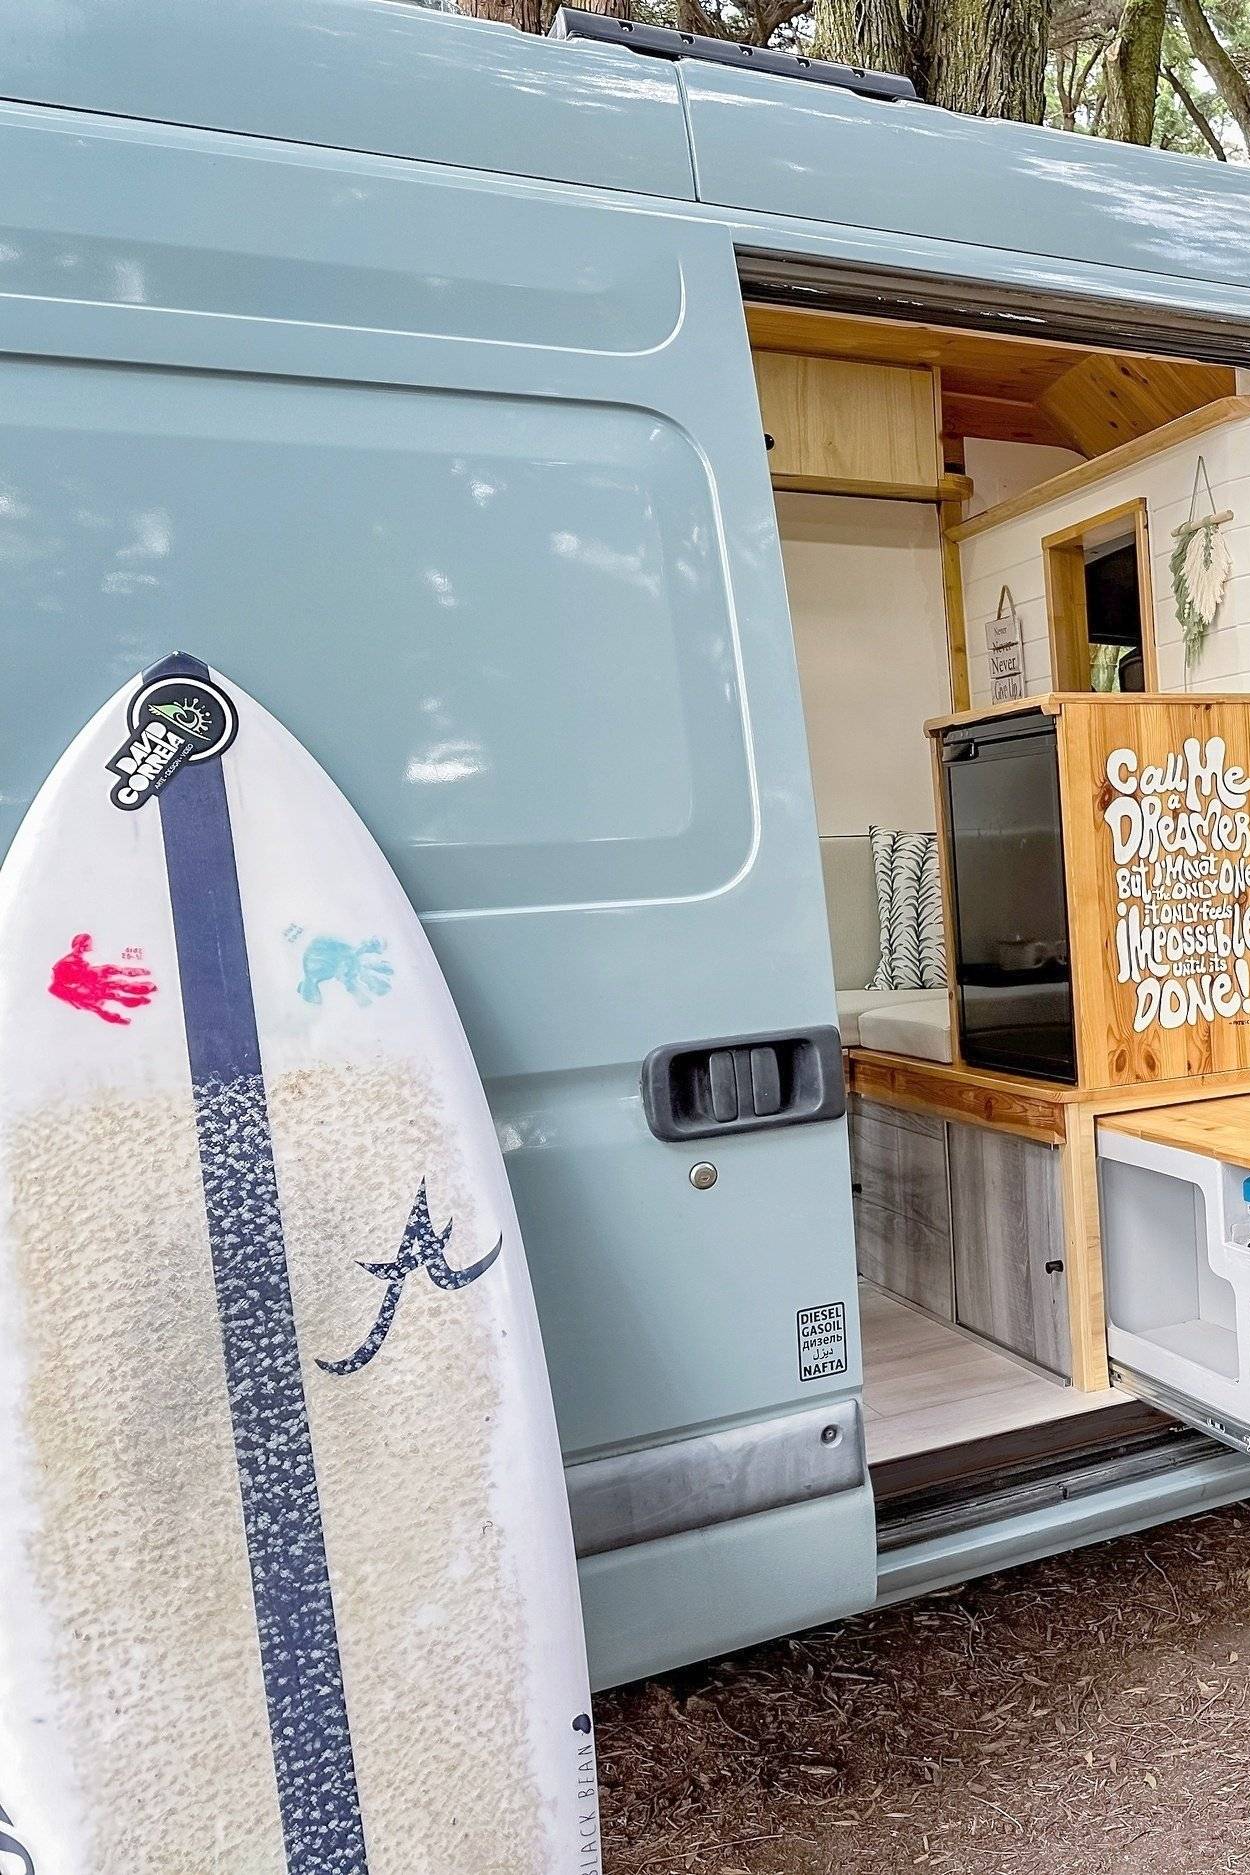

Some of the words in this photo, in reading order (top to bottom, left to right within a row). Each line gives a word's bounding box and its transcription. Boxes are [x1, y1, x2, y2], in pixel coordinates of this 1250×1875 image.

[991, 657, 1015, 674] Never
[115, 721, 168, 776] DAVID
[117, 731, 186, 805] CORREIA
[1106, 748, 1187, 795] Call
[1167, 794, 1182, 809] a
[1116, 859, 1152, 904] But
[1152, 884, 1171, 901] the
[1171, 880, 1219, 900] ONLY
[1160, 903, 1200, 924] ONLY
[1199, 898, 1233, 921] feels
[800, 1307, 841, 1325] DIESEL
[801, 1320, 842, 1337] GASOIL
[802, 1334, 843, 1351] дизель
[813, 1347, 834, 1361] ديزل
[803, 1359, 844, 1377] NAFTA
[577, 1744, 595, 1799] BEAN
